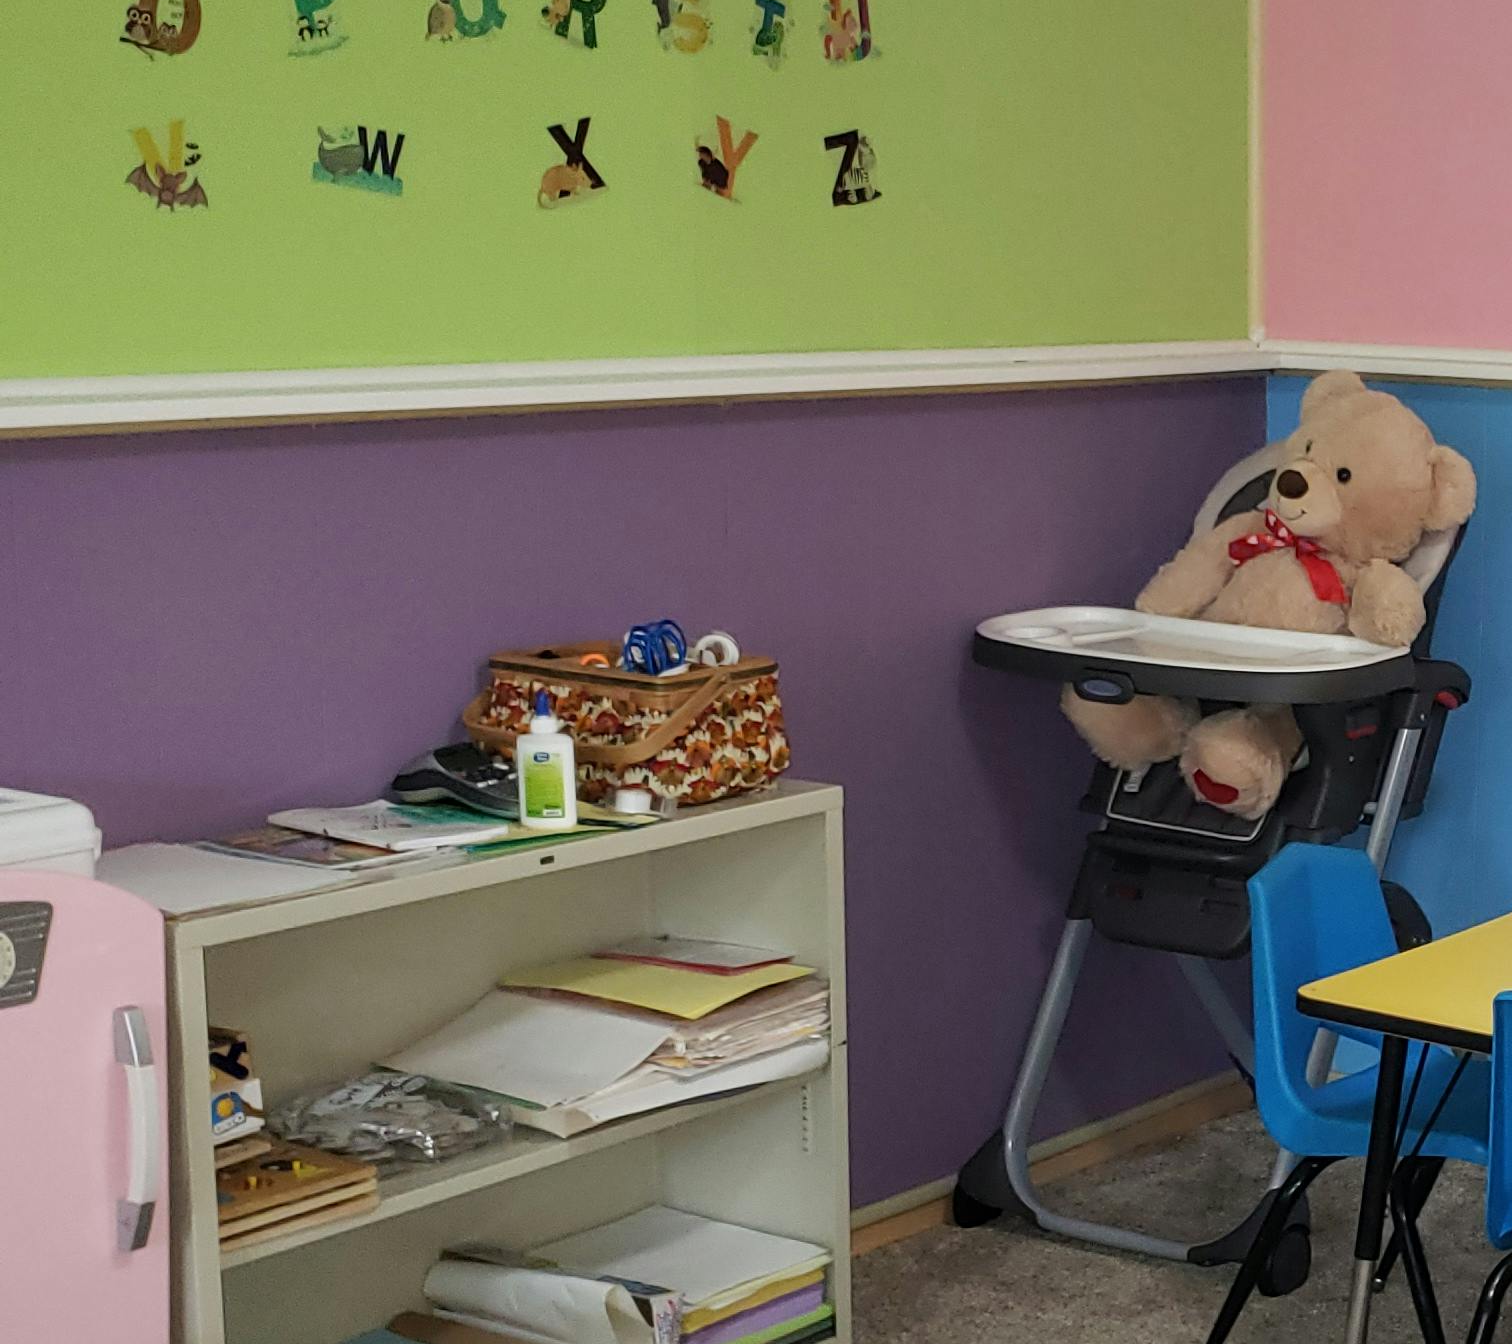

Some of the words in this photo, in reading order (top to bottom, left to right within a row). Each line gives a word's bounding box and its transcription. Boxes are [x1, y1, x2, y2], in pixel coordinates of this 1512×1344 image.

[131, 119, 185, 186] V
[547, 117, 606, 198] X
[716, 115, 759, 198] Y
[824, 129, 882, 207] Z
